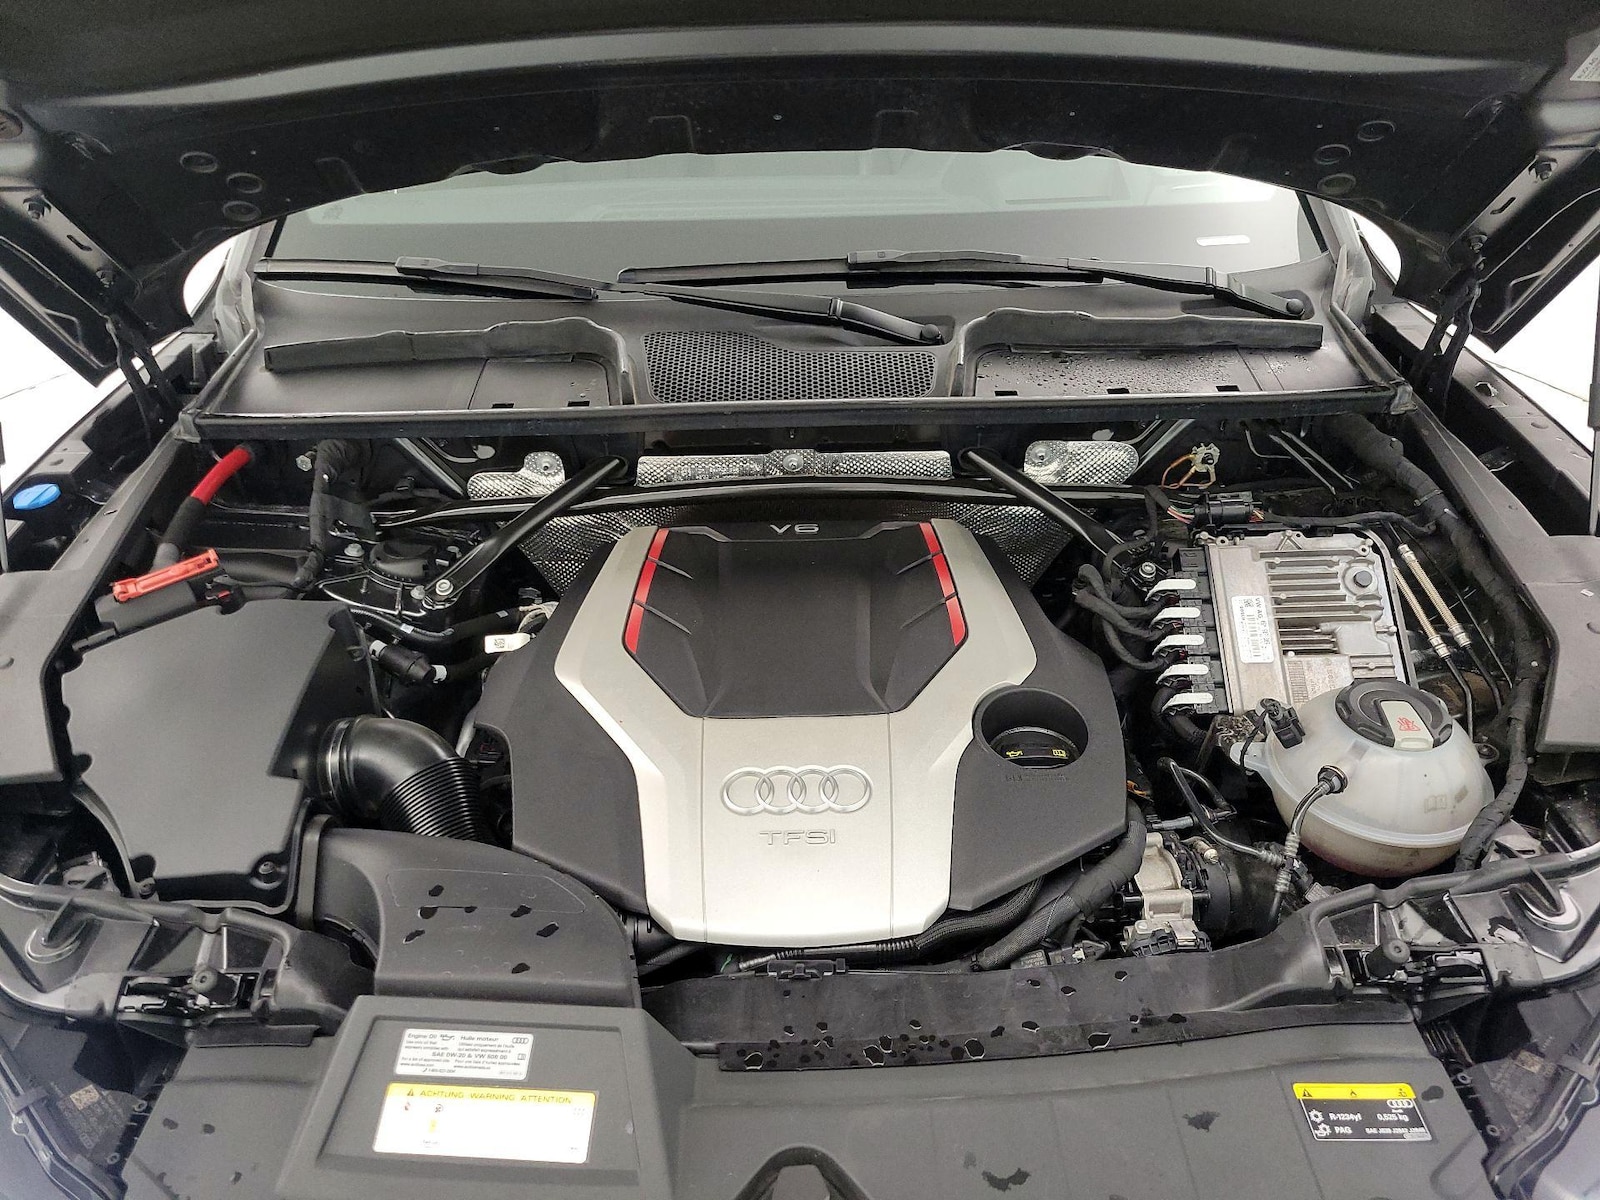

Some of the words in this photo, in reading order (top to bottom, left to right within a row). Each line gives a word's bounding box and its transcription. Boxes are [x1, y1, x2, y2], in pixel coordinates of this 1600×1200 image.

[769, 523, 820, 535] V6
[759, 828, 836, 846] TFSI
[419, 1089, 465, 1099] ACHTUNG
[470, 1091, 516, 1101] WARNING
[520, 1094, 572, 1104] ATTENTION
[1397, 1113, 1410, 1122] kg
[1333, 1126, 1353, 1134] PAG
